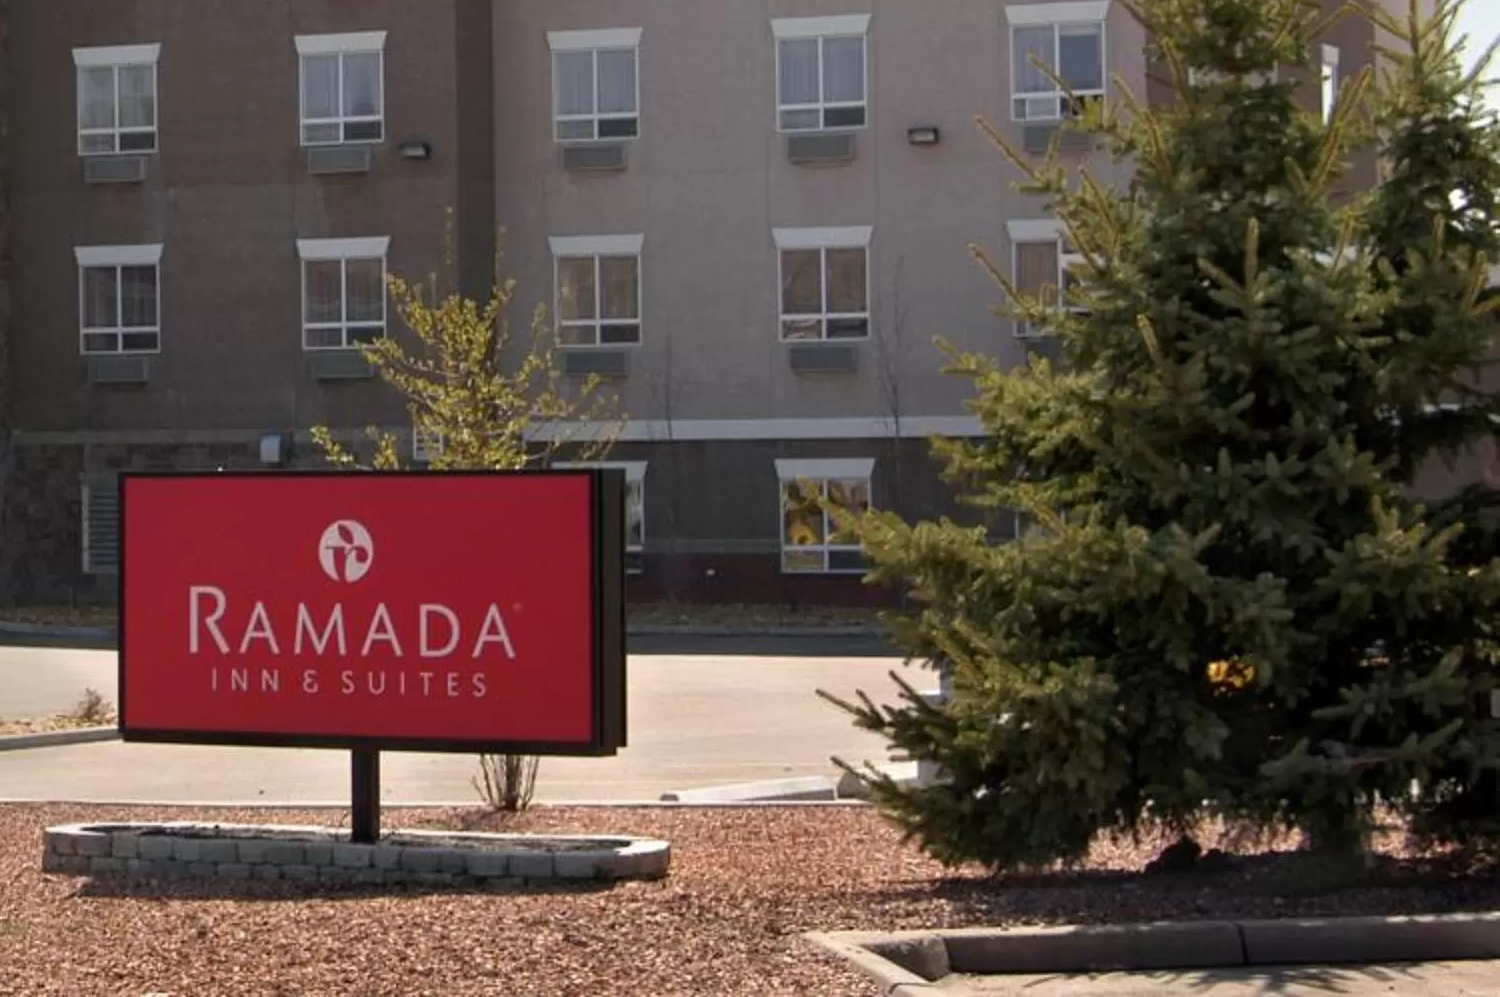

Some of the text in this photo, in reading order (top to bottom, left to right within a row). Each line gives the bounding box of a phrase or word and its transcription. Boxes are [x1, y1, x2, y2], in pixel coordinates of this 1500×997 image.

[189, 585, 516, 658] RAMADA
[211, 668, 487, 697] INN & SUITES
